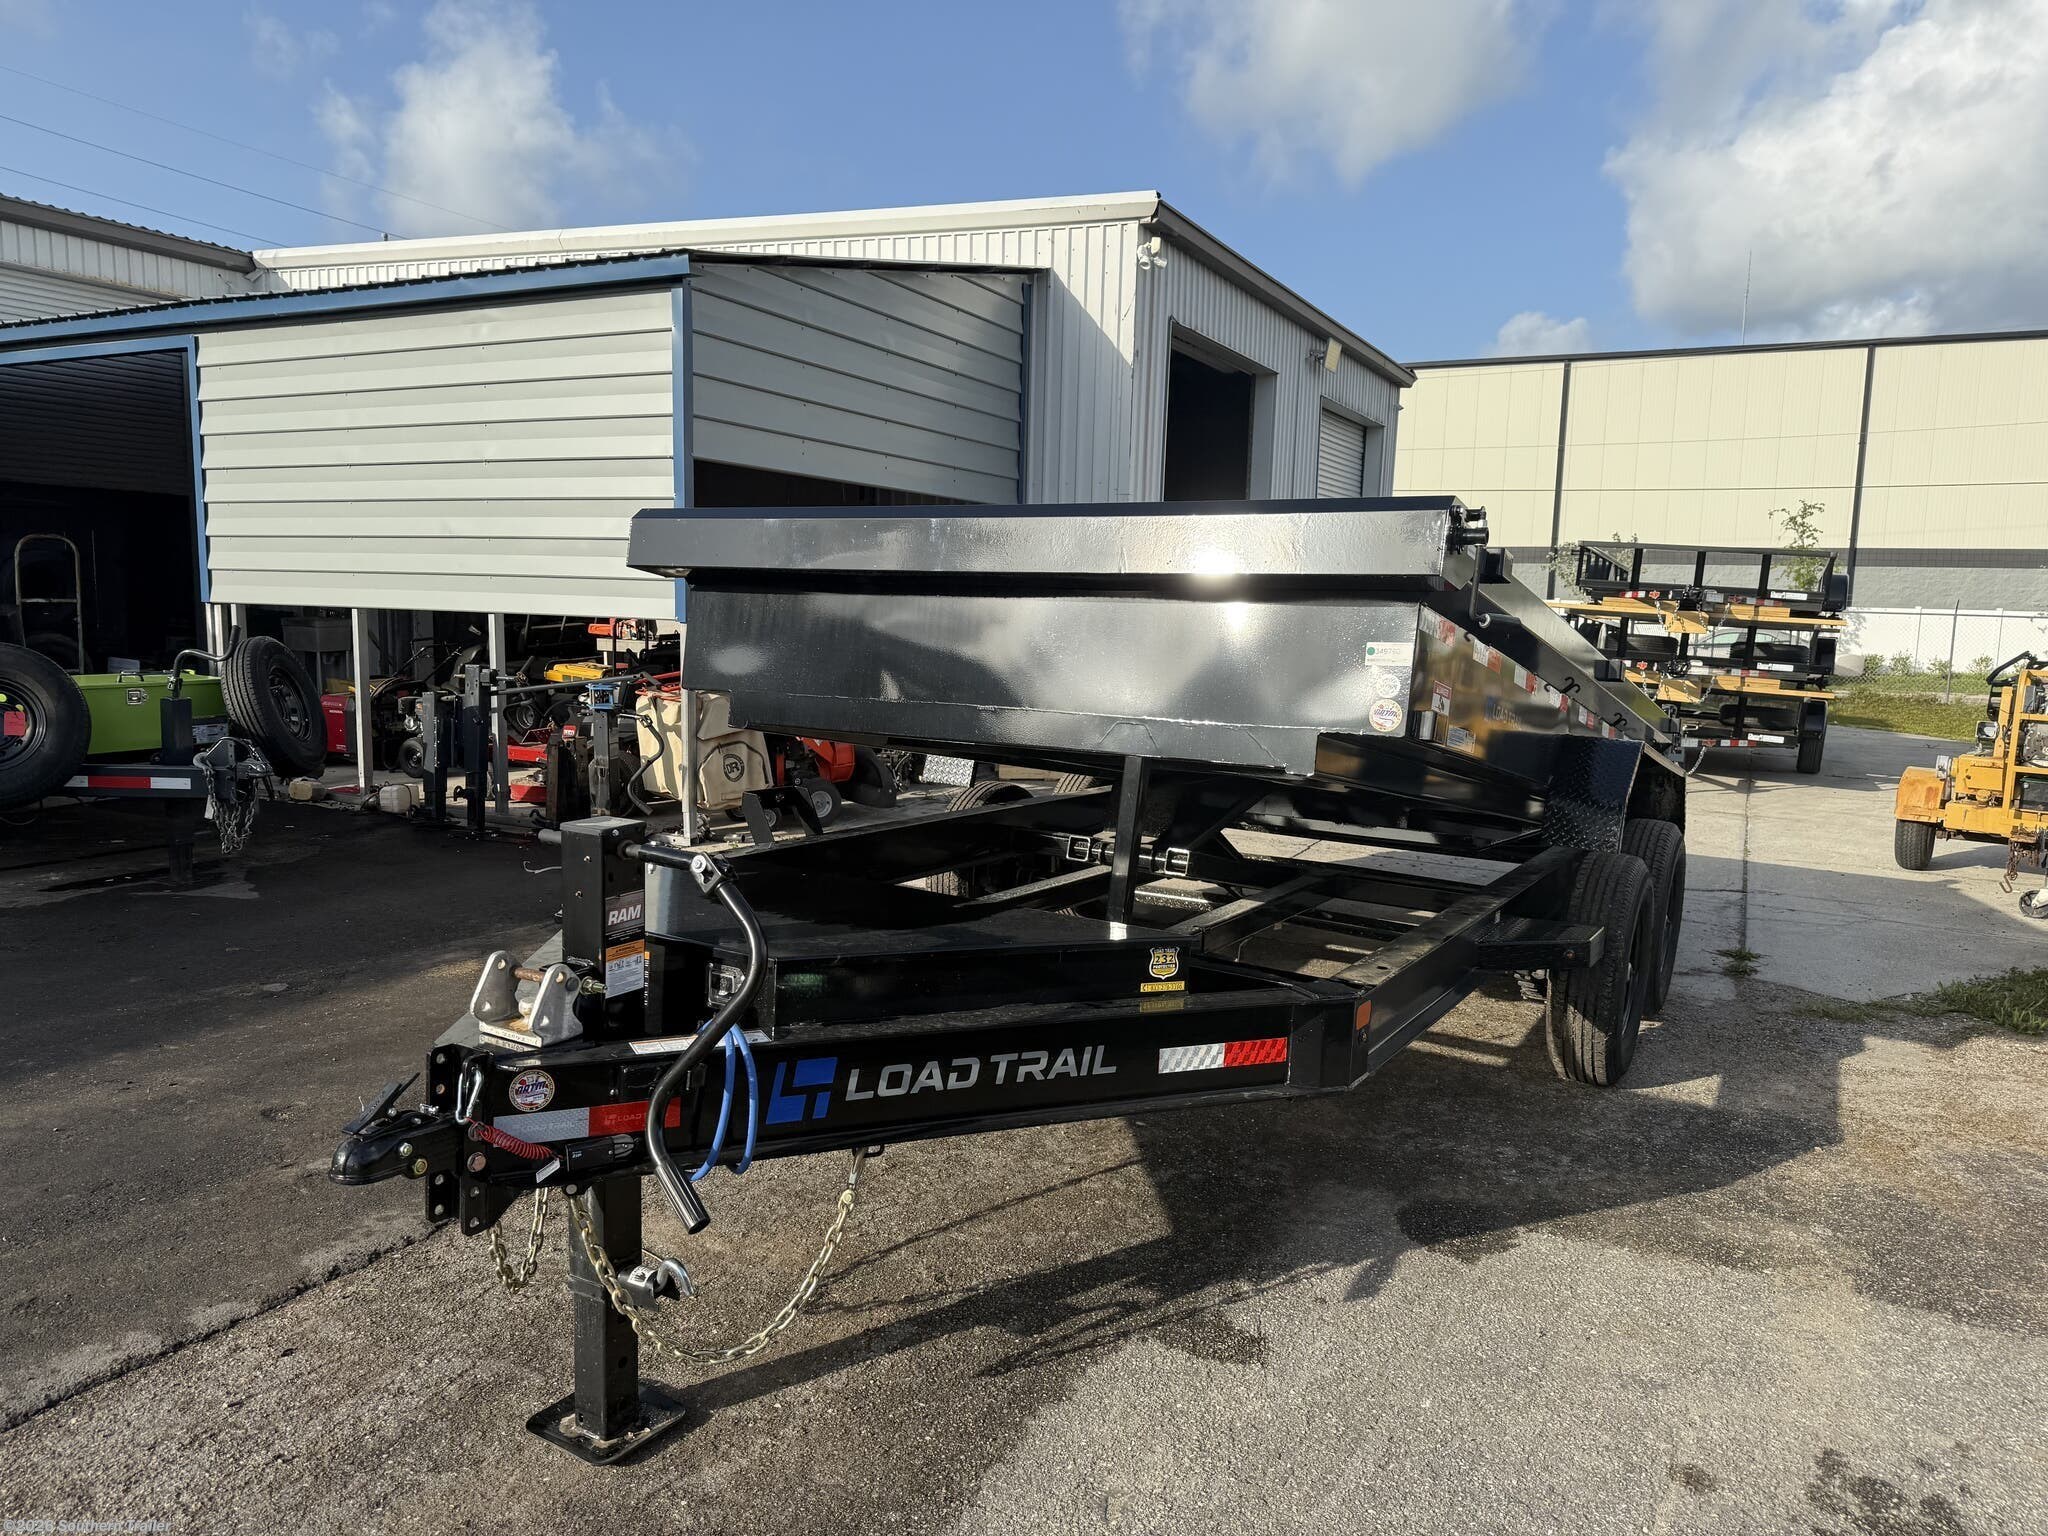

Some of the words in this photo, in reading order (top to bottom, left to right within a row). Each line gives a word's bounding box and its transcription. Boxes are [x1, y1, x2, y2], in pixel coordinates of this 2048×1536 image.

[608, 904, 642, 926] RAM
[1155, 954, 1174, 964] 232
[846, 1057, 981, 1102] LOAD
[990, 1045, 1117, 1085] TRAIL
